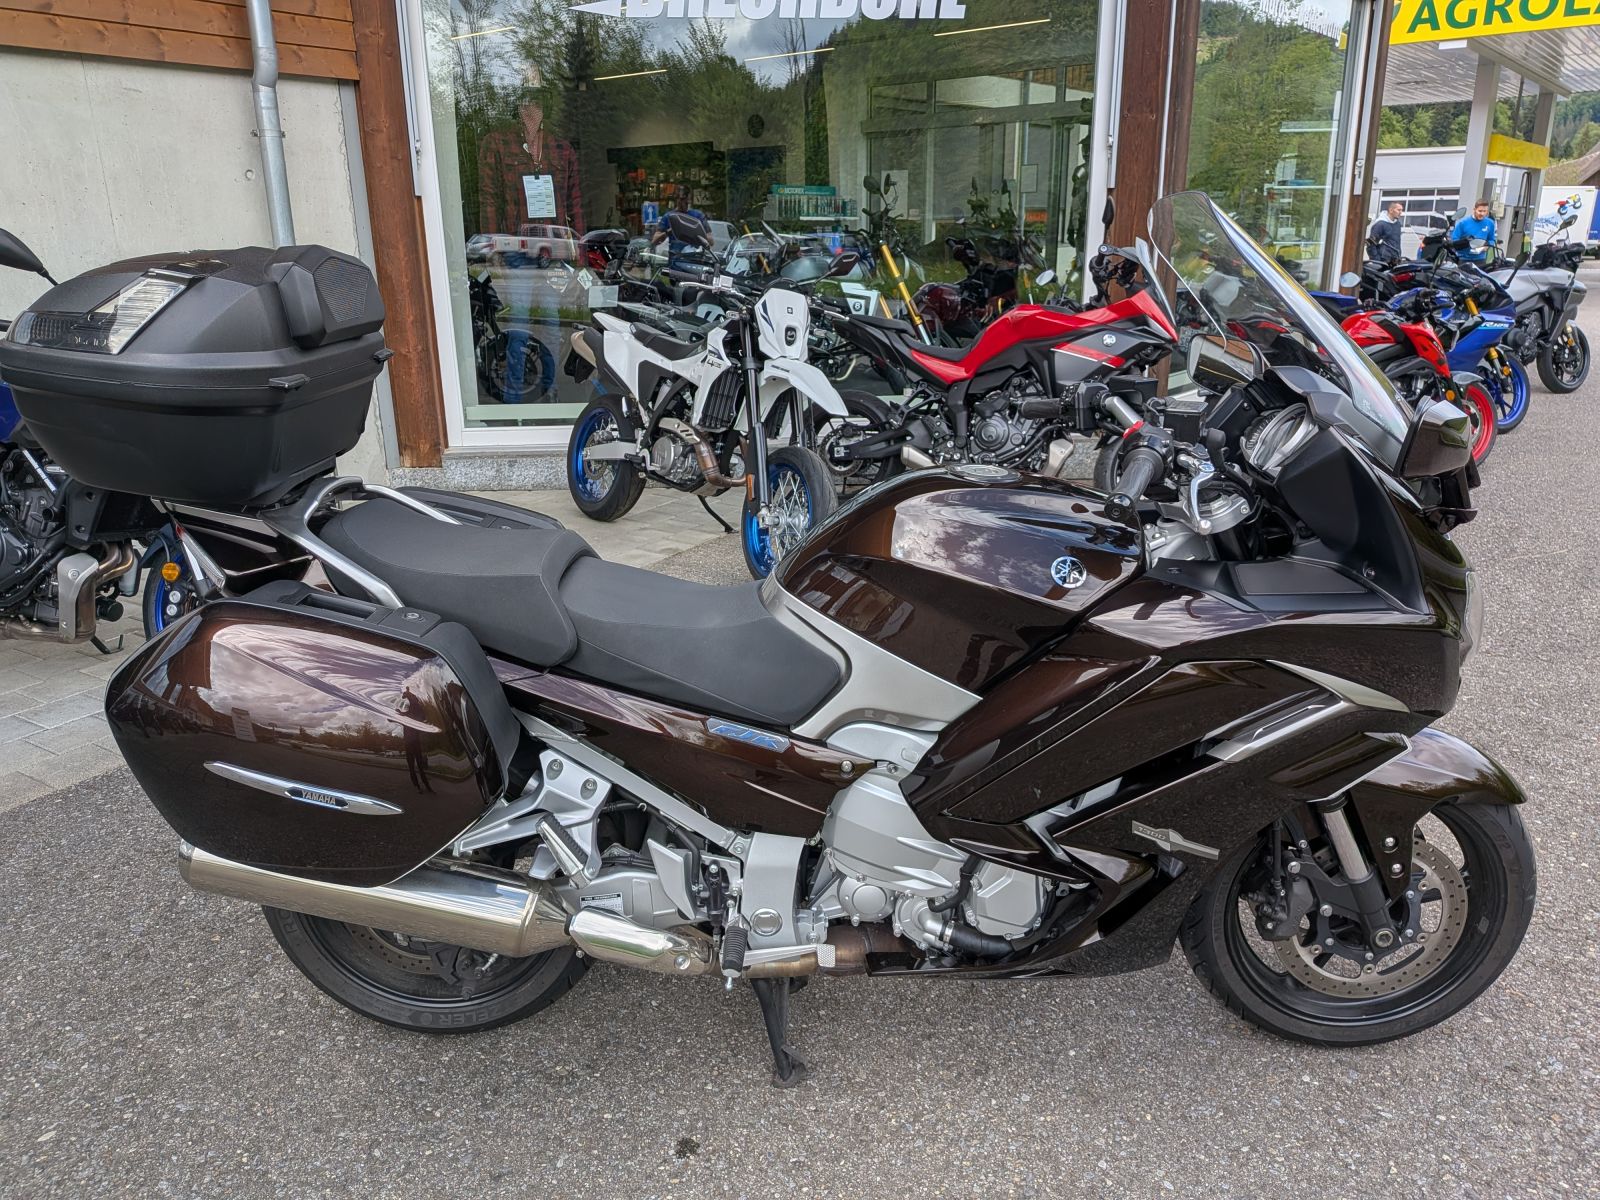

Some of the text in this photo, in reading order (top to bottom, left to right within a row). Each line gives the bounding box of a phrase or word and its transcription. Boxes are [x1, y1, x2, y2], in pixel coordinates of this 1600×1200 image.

[1406, 0, 1600, 34] AGROL
[301, 790, 336, 805] YAMAHA
[1137, 826, 1167, 841] 1300
